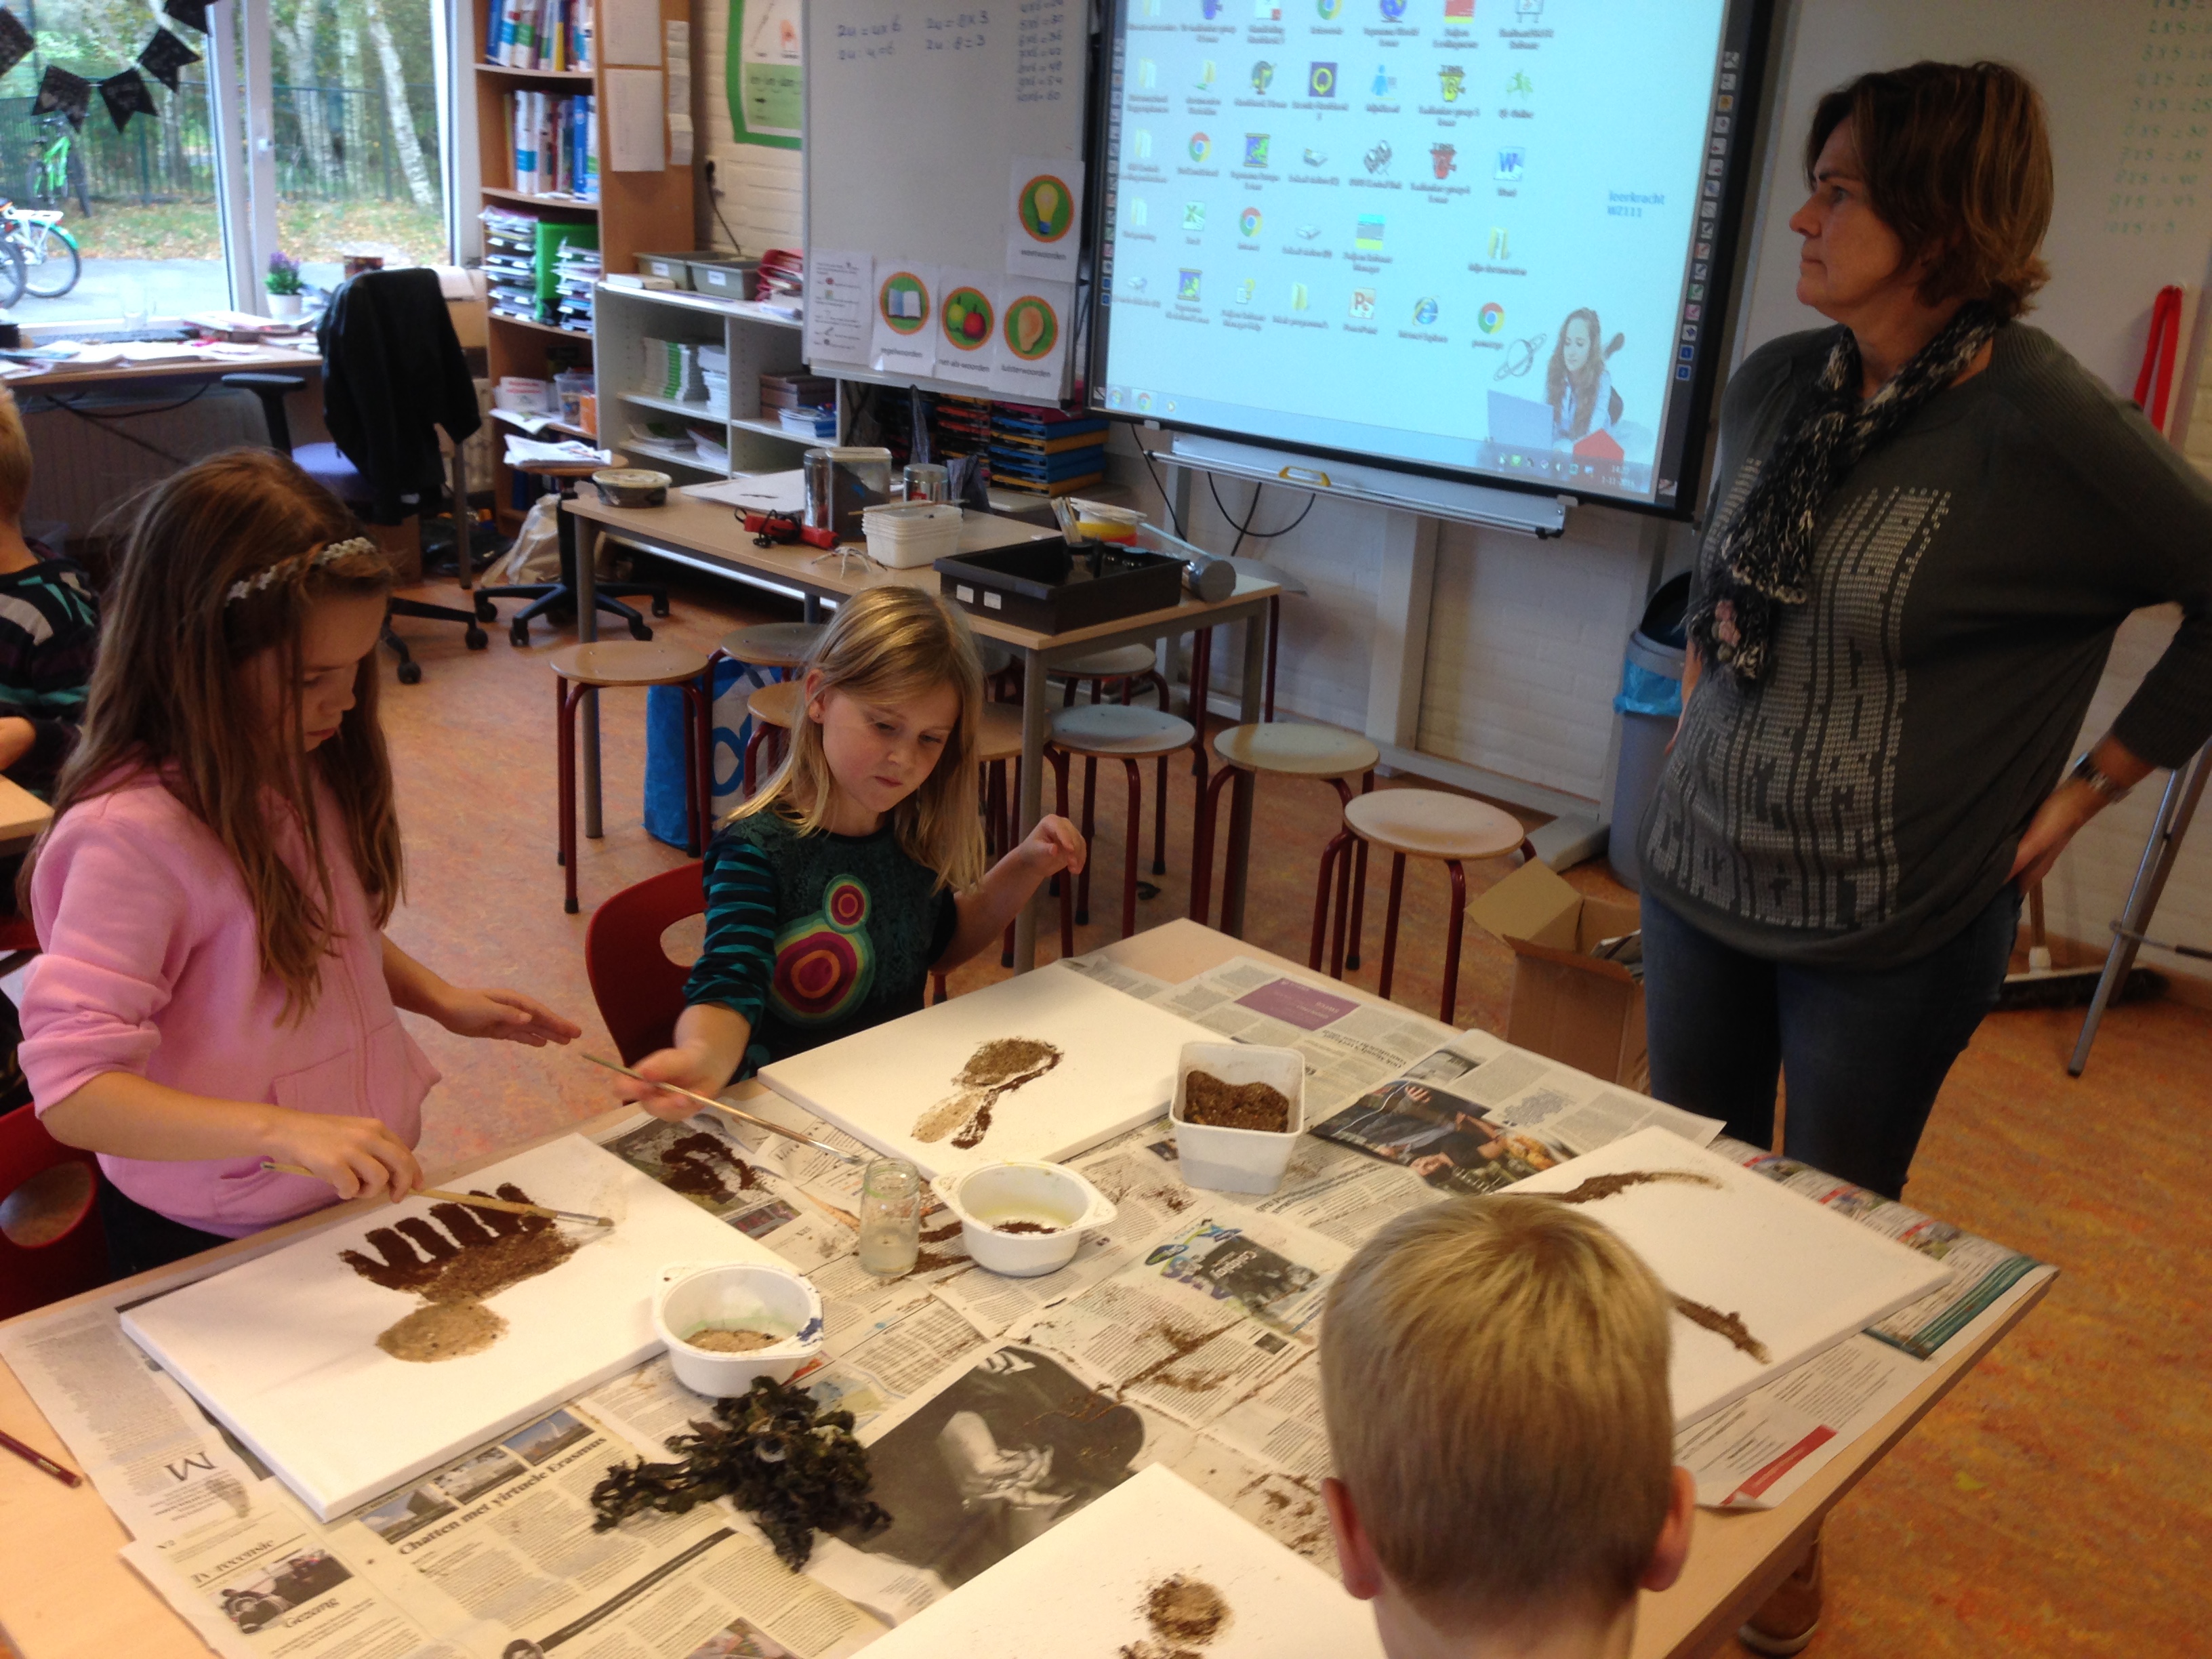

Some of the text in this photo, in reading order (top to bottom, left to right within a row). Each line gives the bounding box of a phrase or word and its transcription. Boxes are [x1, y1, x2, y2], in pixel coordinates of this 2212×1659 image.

[398, 1520, 461, 1555] Chatten
[461, 1503, 491, 1523] met
[546, 1436, 607, 1474] Erasmus
